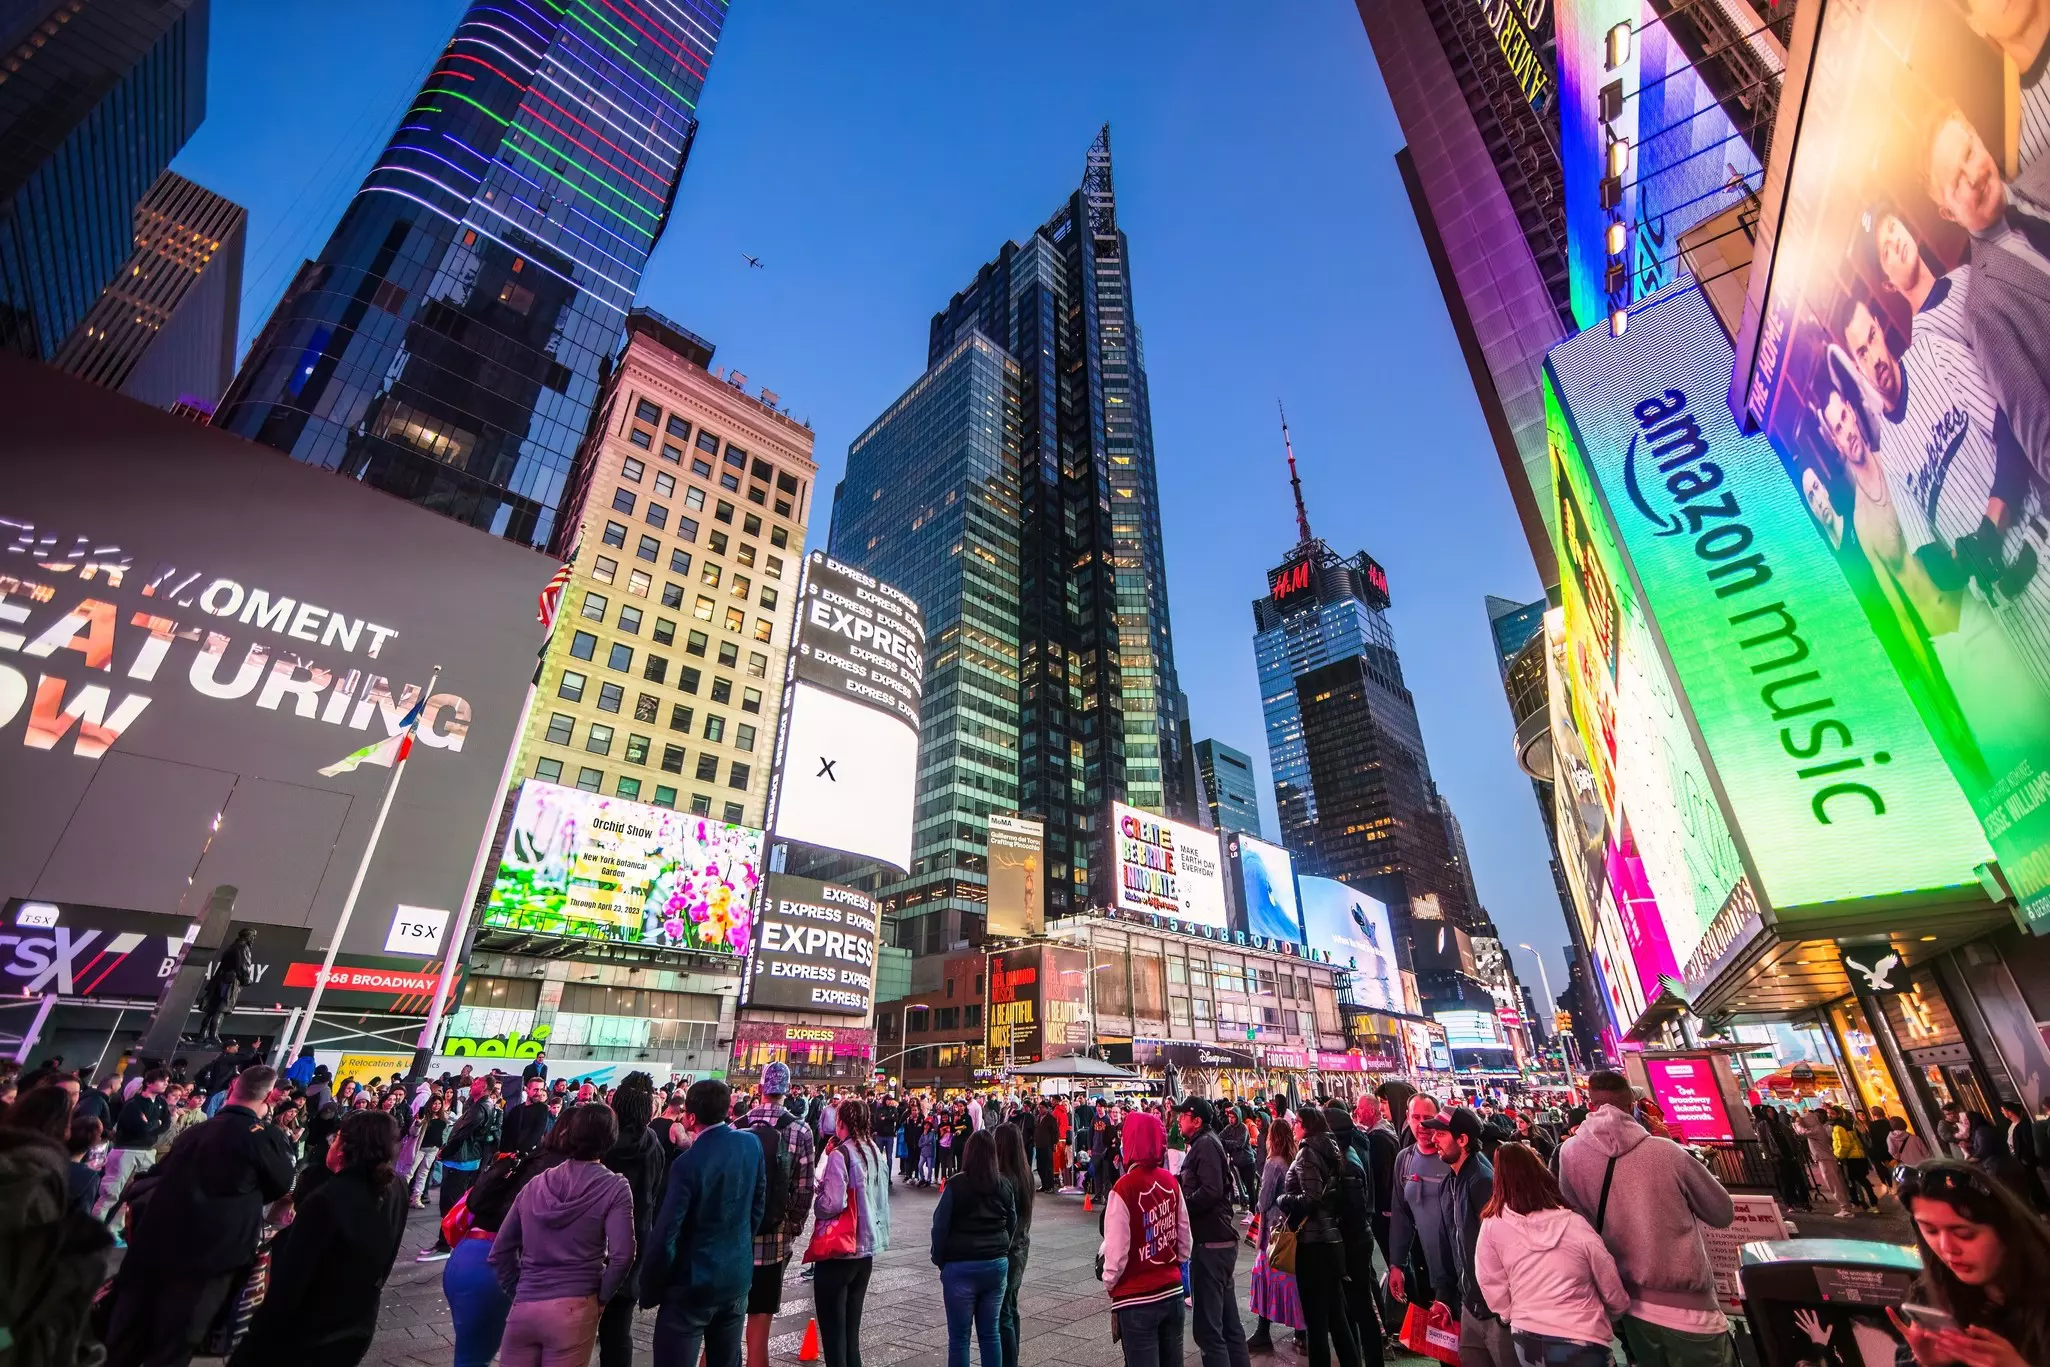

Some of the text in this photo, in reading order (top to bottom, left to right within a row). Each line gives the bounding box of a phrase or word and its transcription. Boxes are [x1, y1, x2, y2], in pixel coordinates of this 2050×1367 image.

[826, 558, 876, 589] EXPRESS
[879, 582, 919, 614] EXPRESS
[1272, 561, 1309, 601] H&M
[856, 587, 903, 617] EXPRESS
[1634, 387, 1893, 827] amazon music
[822, 589, 873, 619] EXPRESS
[876, 612, 916, 643] EXPRESS
[810, 598, 924, 681] EXPRESS
[850, 645, 898, 673] EXPRESS
[814, 648, 867, 677] EXPRESS
[871, 670, 912, 699] EXPRESS
[846, 678, 896, 706] EXPRESS
[816, 756, 837, 782] X
[593, 817, 653, 840] Orchid Show
[991, 817, 1012, 827] MoMA
[1983, 804, 2012, 841] JESSE
[990, 831, 1018, 842] Guillermo
[990, 838, 1041, 852] Crafting Pinocchio
[1180, 844, 1199, 857] MAKE
[583, 852, 648, 871] New York Botanical
[1181, 853, 1215, 871] EARTH DAY
[1181, 862, 1214, 878] EVERYDAY
[601, 866, 626, 879] Garden
[570, 898, 597, 910] Through
[597, 902, 613, 913] April
[624, 905, 641, 915] 2023
[822, 886, 869, 910] EXPRESS
[24, 914, 52, 925] TSX
[779, 900, 842, 923] EXPRESS
[399, 922, 438, 940] TSX
[760, 921, 873, 968] EXPRESS
[771, 961, 836, 982] EXPRESS
[992, 957, 1004, 974] THE
[351, 970, 436, 991] BROADWAY
[812, 987, 861, 1006] EXPRESS
[991, 999, 1034, 1025] A BEAUTIFUL
[1044, 1001, 1050, 1022] A
[785, 1028, 835, 1041] EXPRESS
[990, 1025, 1011, 1049] NOISE
[1044, 1022, 1067, 1045] NOISE
[348, 1058, 395, 1068] Relocation
[396, 1060, 403, 1068] &
[1198, 1049, 1232, 1067] Disney store
[1266, 1051, 1294, 1068] FOREVER
[1295, 1054, 1304, 1068] 21
[973, 1068, 992, 1077] GIFTS
[1668, 1096, 1711, 1105] Broadway
[1678, 1087, 1696, 1096] Get
[1673, 1104, 1712, 1112] tickets in
[1757, 1214, 1776, 1223] NYC
